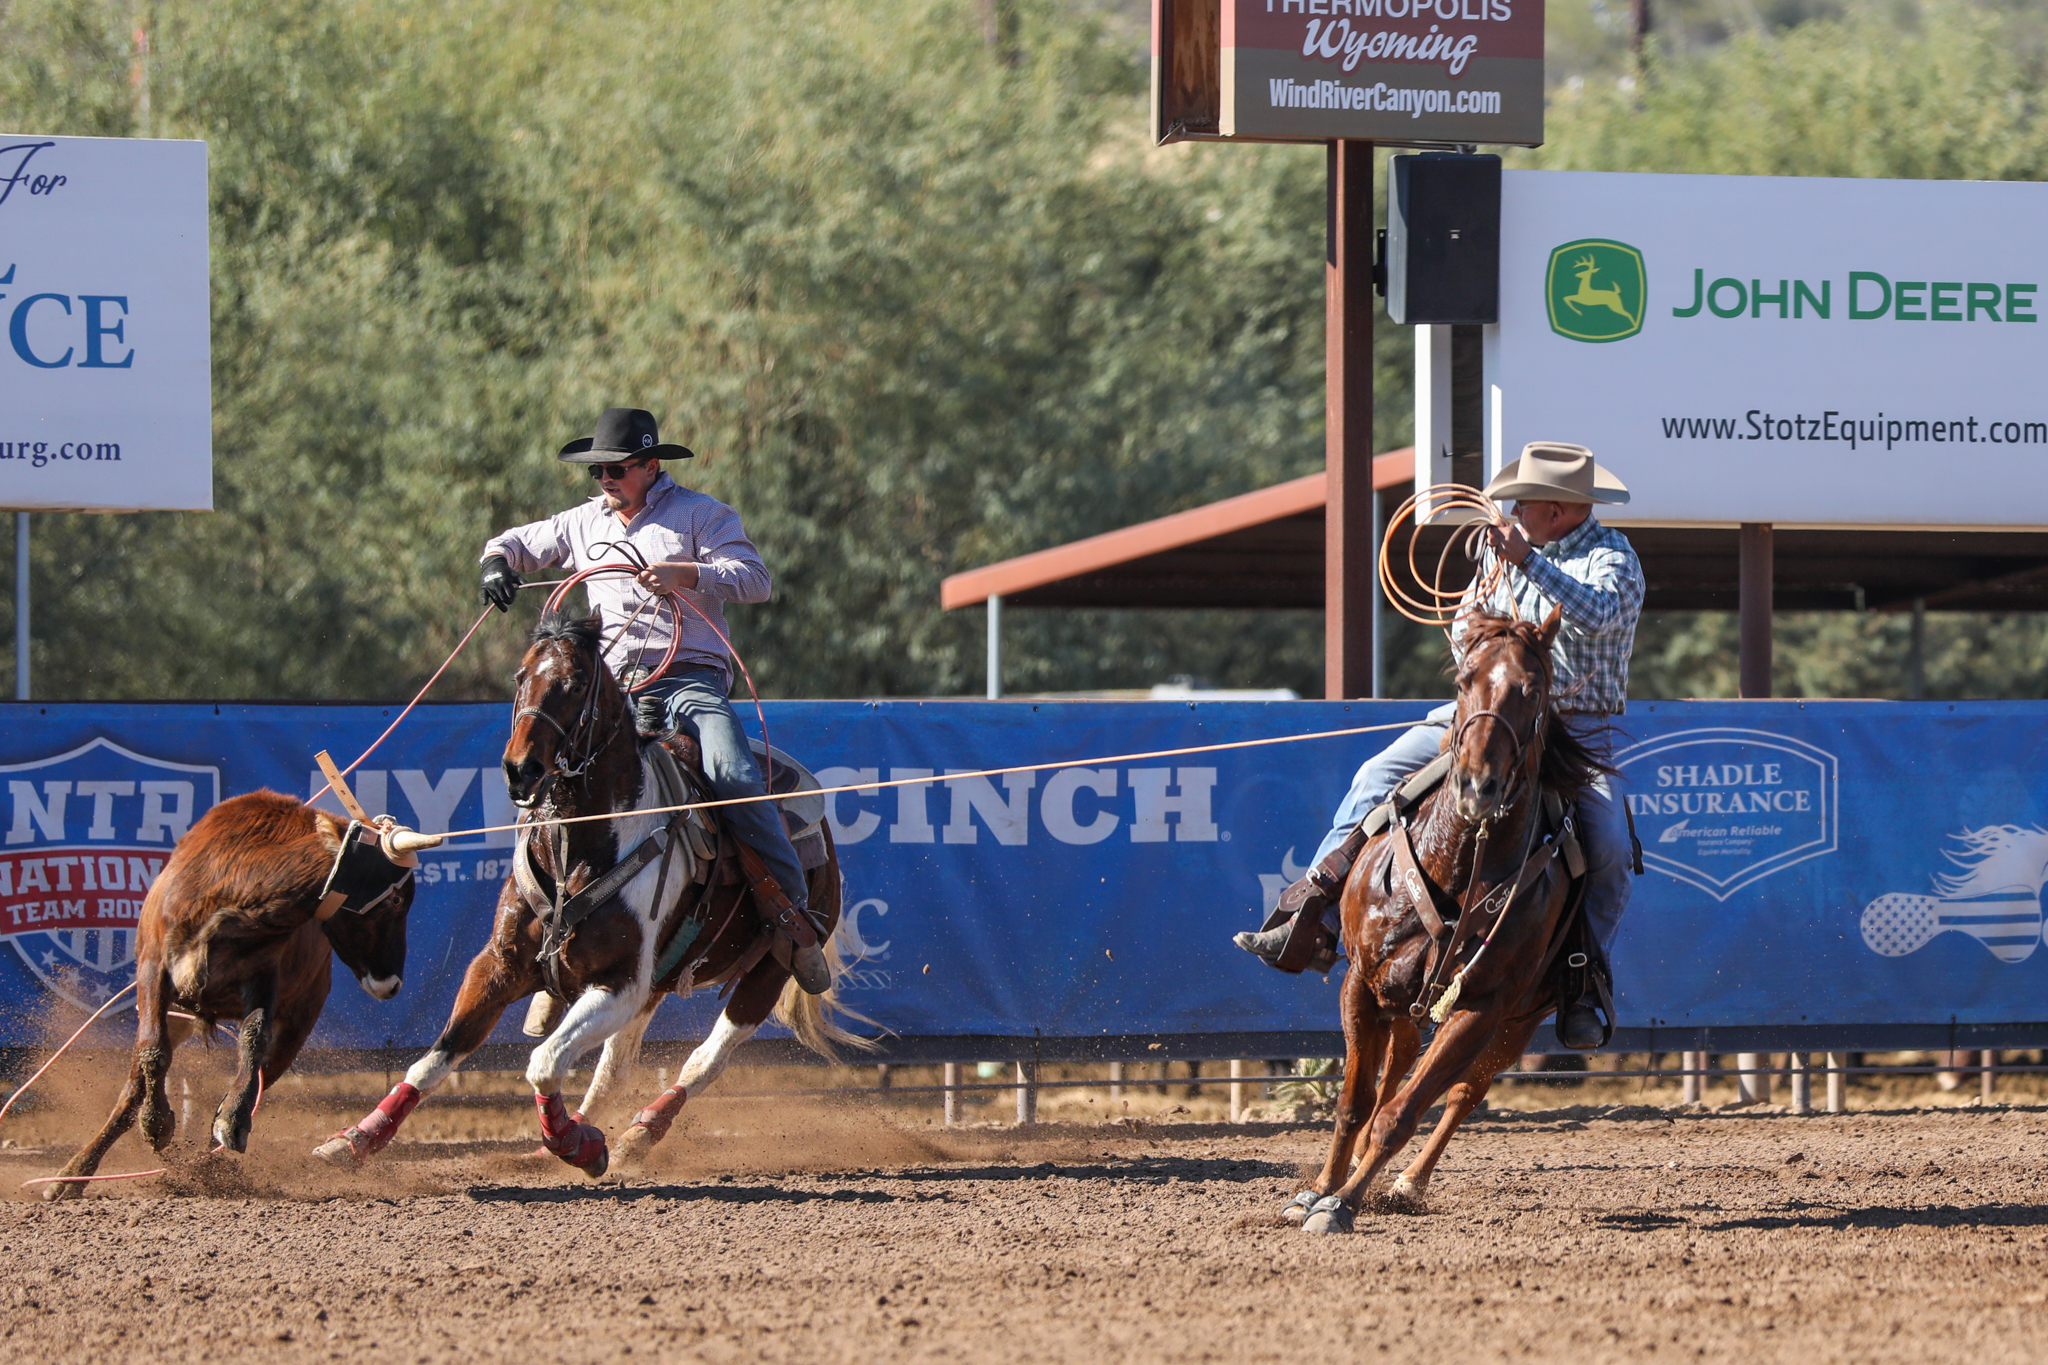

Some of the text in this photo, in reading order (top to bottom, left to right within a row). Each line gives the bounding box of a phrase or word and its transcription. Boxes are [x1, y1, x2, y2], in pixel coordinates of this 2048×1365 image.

[1302, 18, 1478, 76] Wyoming
[1269, 78, 1501, 119] WindRiverCanyon.com
[1672, 268, 2038, 323] JOHN DEERE
[0, 292, 135, 369] CE
[1661, 410, 2048, 450] www.StotzEquipment.com
[1656, 763, 1782, 788] SHADLE
[5, 780, 194, 845] NTR
[814, 766, 1218, 846] CINCH
[1626, 790, 1812, 816] INSURANCE
[1667, 825, 1782, 839] American Reliable
[476, 858, 513, 881] 187
[6, 899, 86, 925] TEAM
